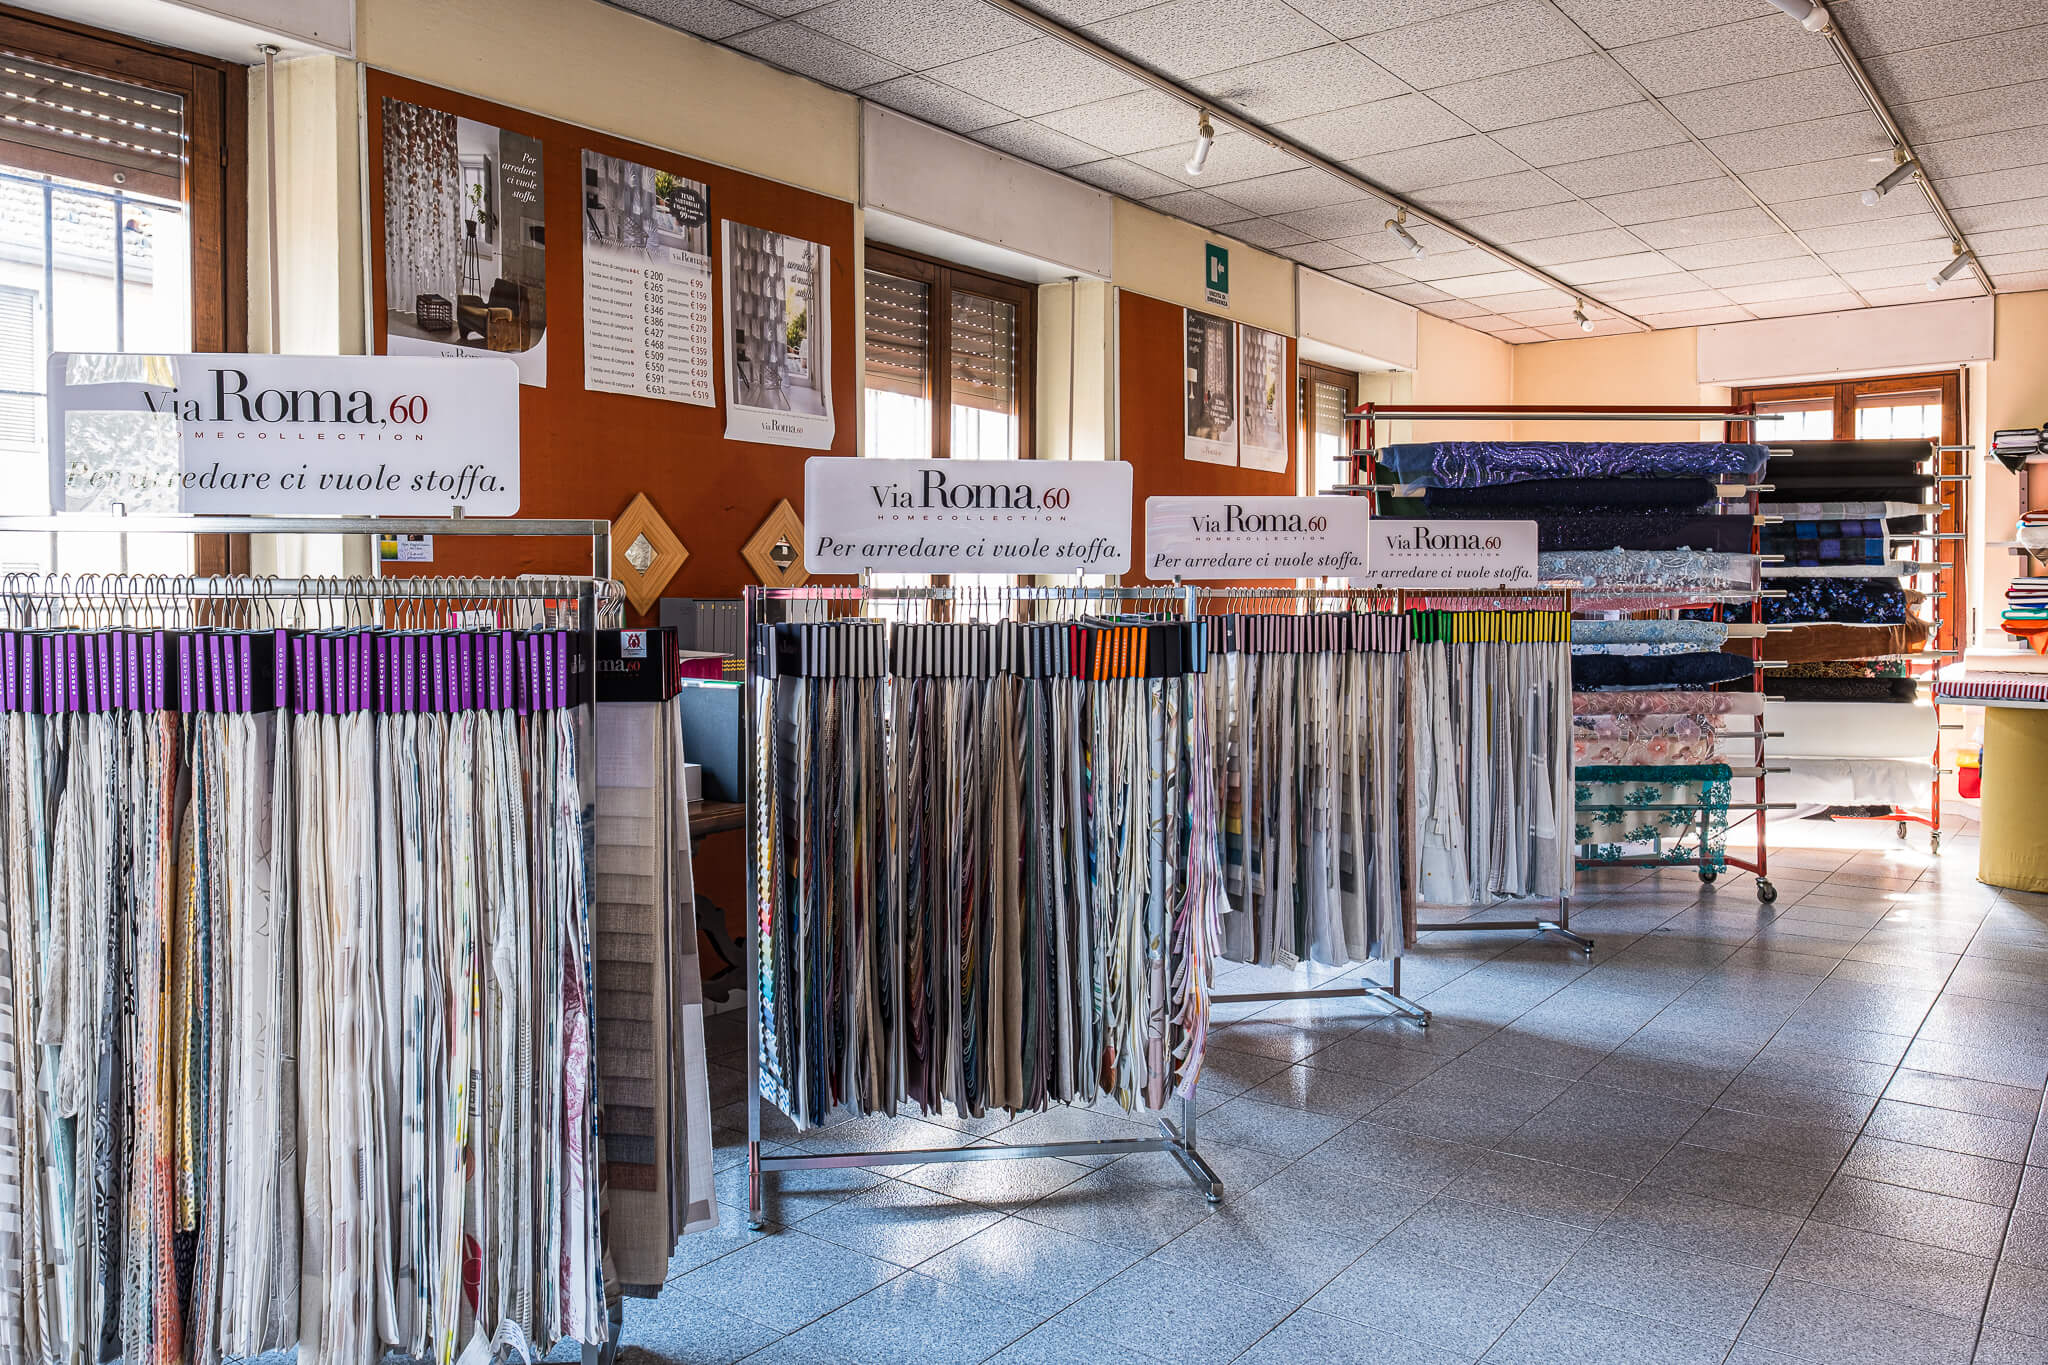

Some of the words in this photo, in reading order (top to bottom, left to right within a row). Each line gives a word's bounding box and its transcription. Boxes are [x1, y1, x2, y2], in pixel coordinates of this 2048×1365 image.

[522, 153, 536, 164] Per
[502, 163, 536, 176] arredare
[506, 176, 514, 184] ci
[516, 179, 536, 189] vuole
[512, 191, 536, 202] stoffa.
[280, 464, 307, 490] ci
[320, 464, 401, 491] vuole
[411, 464, 505, 500] stoffa.
[870, 484, 914, 508] Via
[1192, 515, 1220, 532] Via
[816, 536, 855, 557] Per
[862, 537, 959, 557] arredare
[966, 538, 986, 557] ci
[993, 538, 1050, 557] vuole
[1056, 538, 1120, 563] stoffa.
[1386, 536, 1410, 549] Via
[1154, 553, 1181, 568] Per
[1186, 553, 1252, 568] arredare
[1256, 553, 1270, 567] ci
[1274, 552, 1313, 566] vuole
[1317, 552, 1362, 570] stoffa.
[1366, 570, 1378, 578] er
[1381, 566, 1436, 578] arredare
[1441, 566, 1452, 578] ci
[1456, 566, 1489, 578] vuole
[1493, 566, 1532, 581] stoffa.
